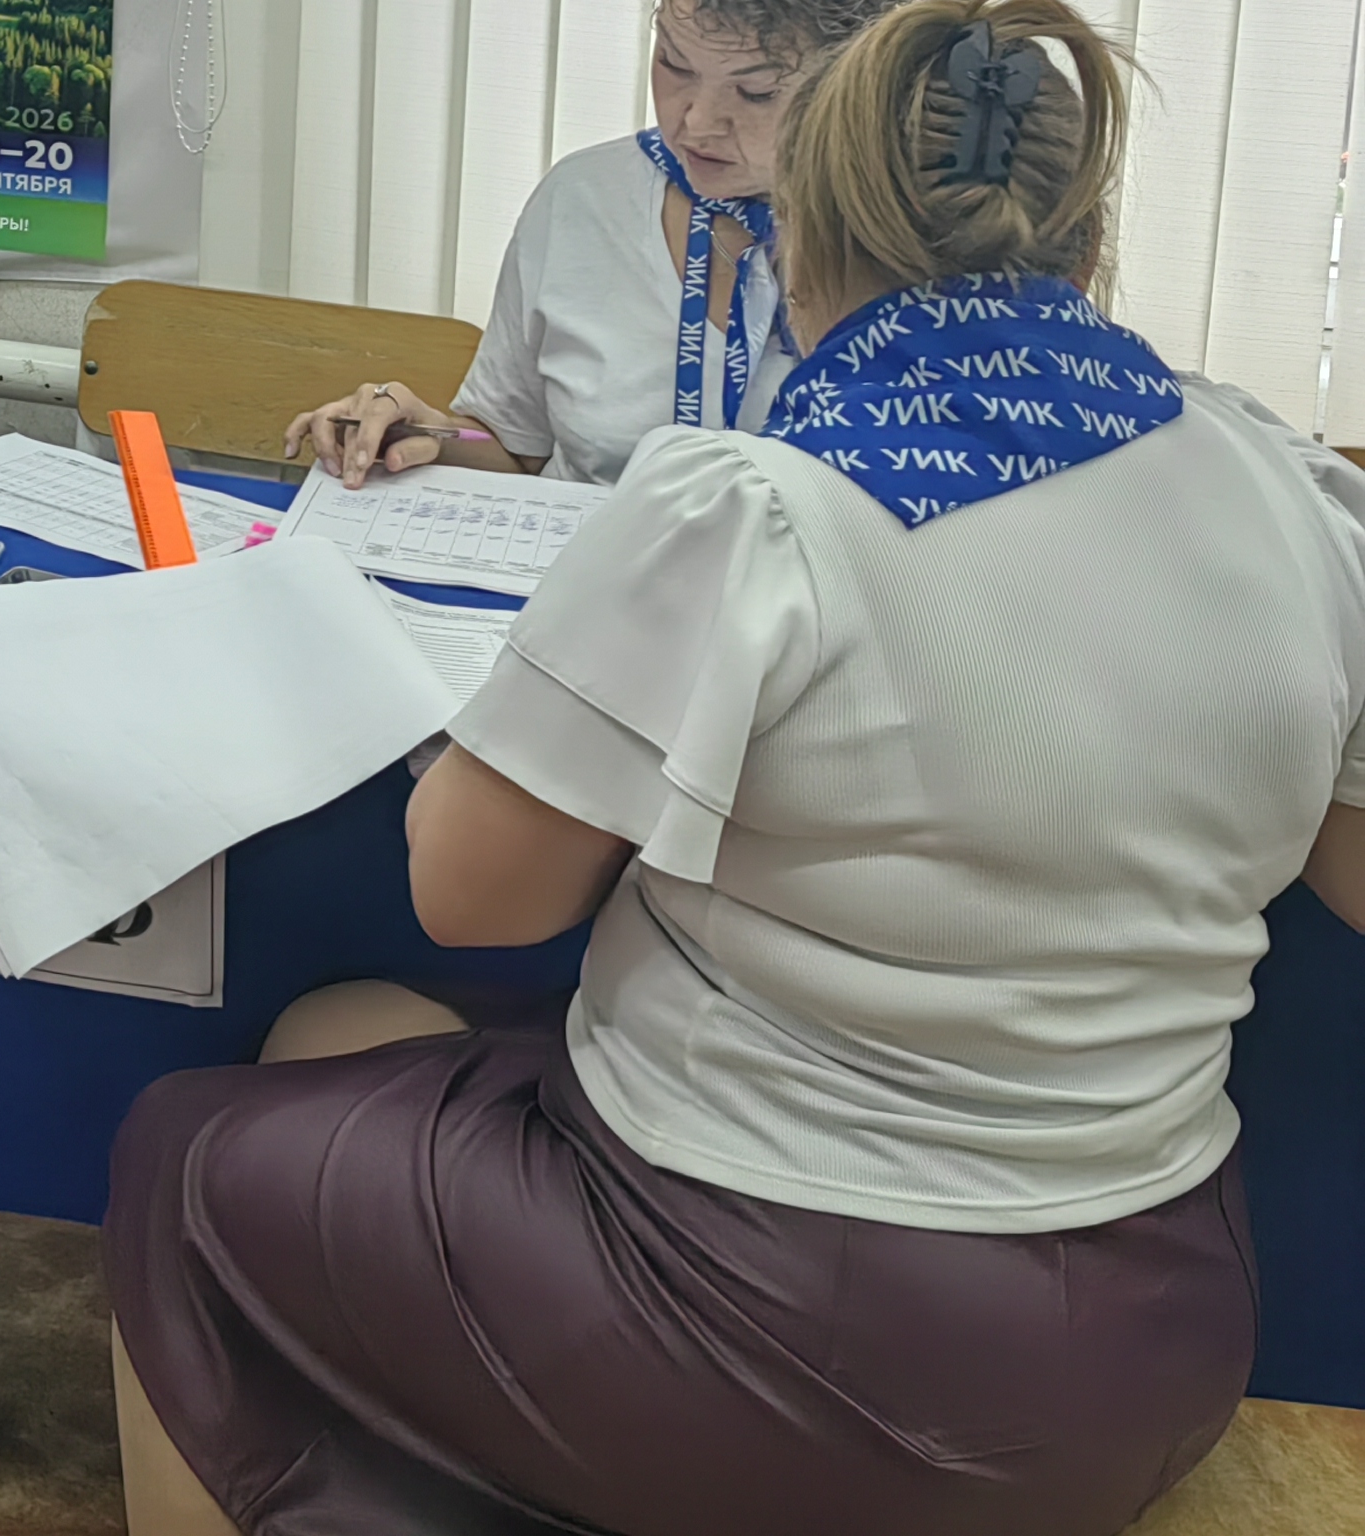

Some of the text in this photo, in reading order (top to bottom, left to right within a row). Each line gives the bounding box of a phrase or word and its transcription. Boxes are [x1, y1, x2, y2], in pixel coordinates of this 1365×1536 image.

[5, 105, 74, 132] 2026
[684, 253, 707, 299] УИК
[679, 321, 703, 366] УИК
[835, 310, 913, 374] УИК
[919, 297, 1020, 329] УИК
[1045, 348, 1122, 391] УИК
[1124, 368, 1182, 399] УИ
[676, 389, 700, 425] ИК
[863, 392, 962, 427] УИК
[971, 392, 1066, 428] УИК
[1071, 402, 1141, 441] УИК
[880, 447, 978, 477] УИК
